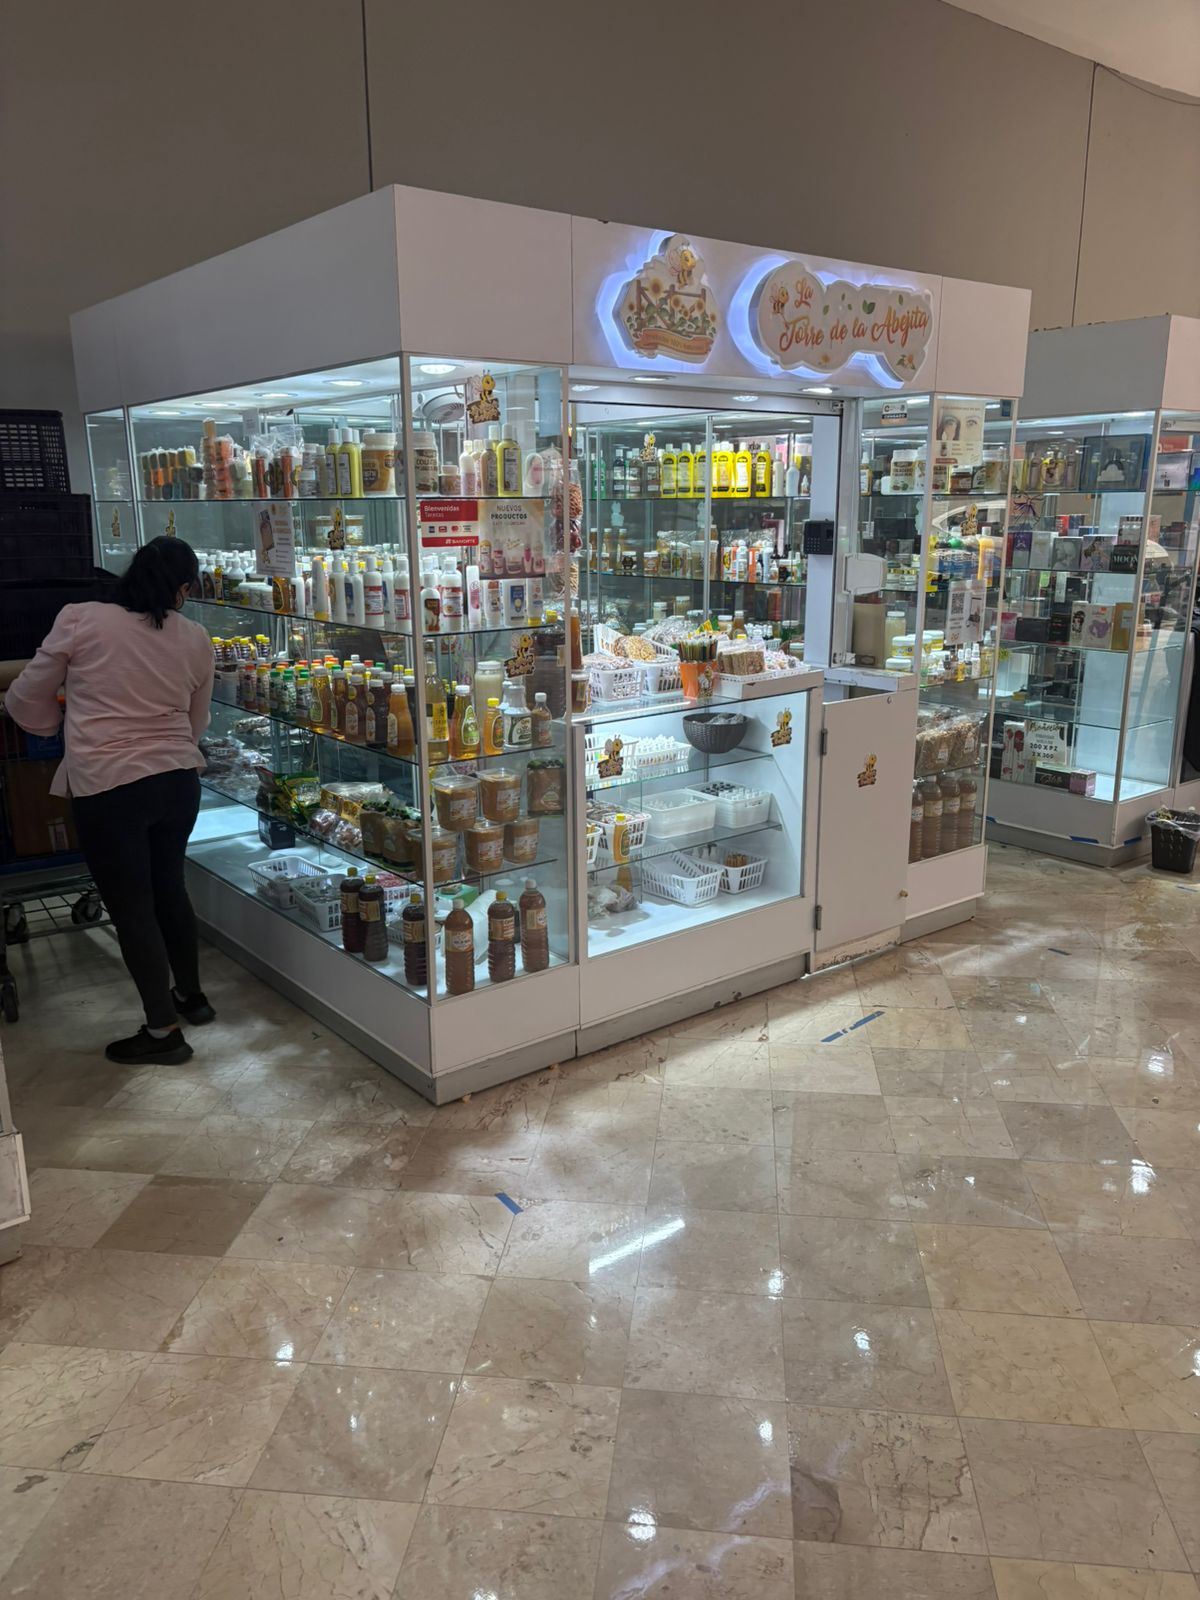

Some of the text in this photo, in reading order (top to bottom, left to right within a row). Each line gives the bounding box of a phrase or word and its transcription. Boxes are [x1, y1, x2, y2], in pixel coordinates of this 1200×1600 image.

[795, 279, 813, 307] La
[779, 305, 929, 351] Torre de la Abejita
